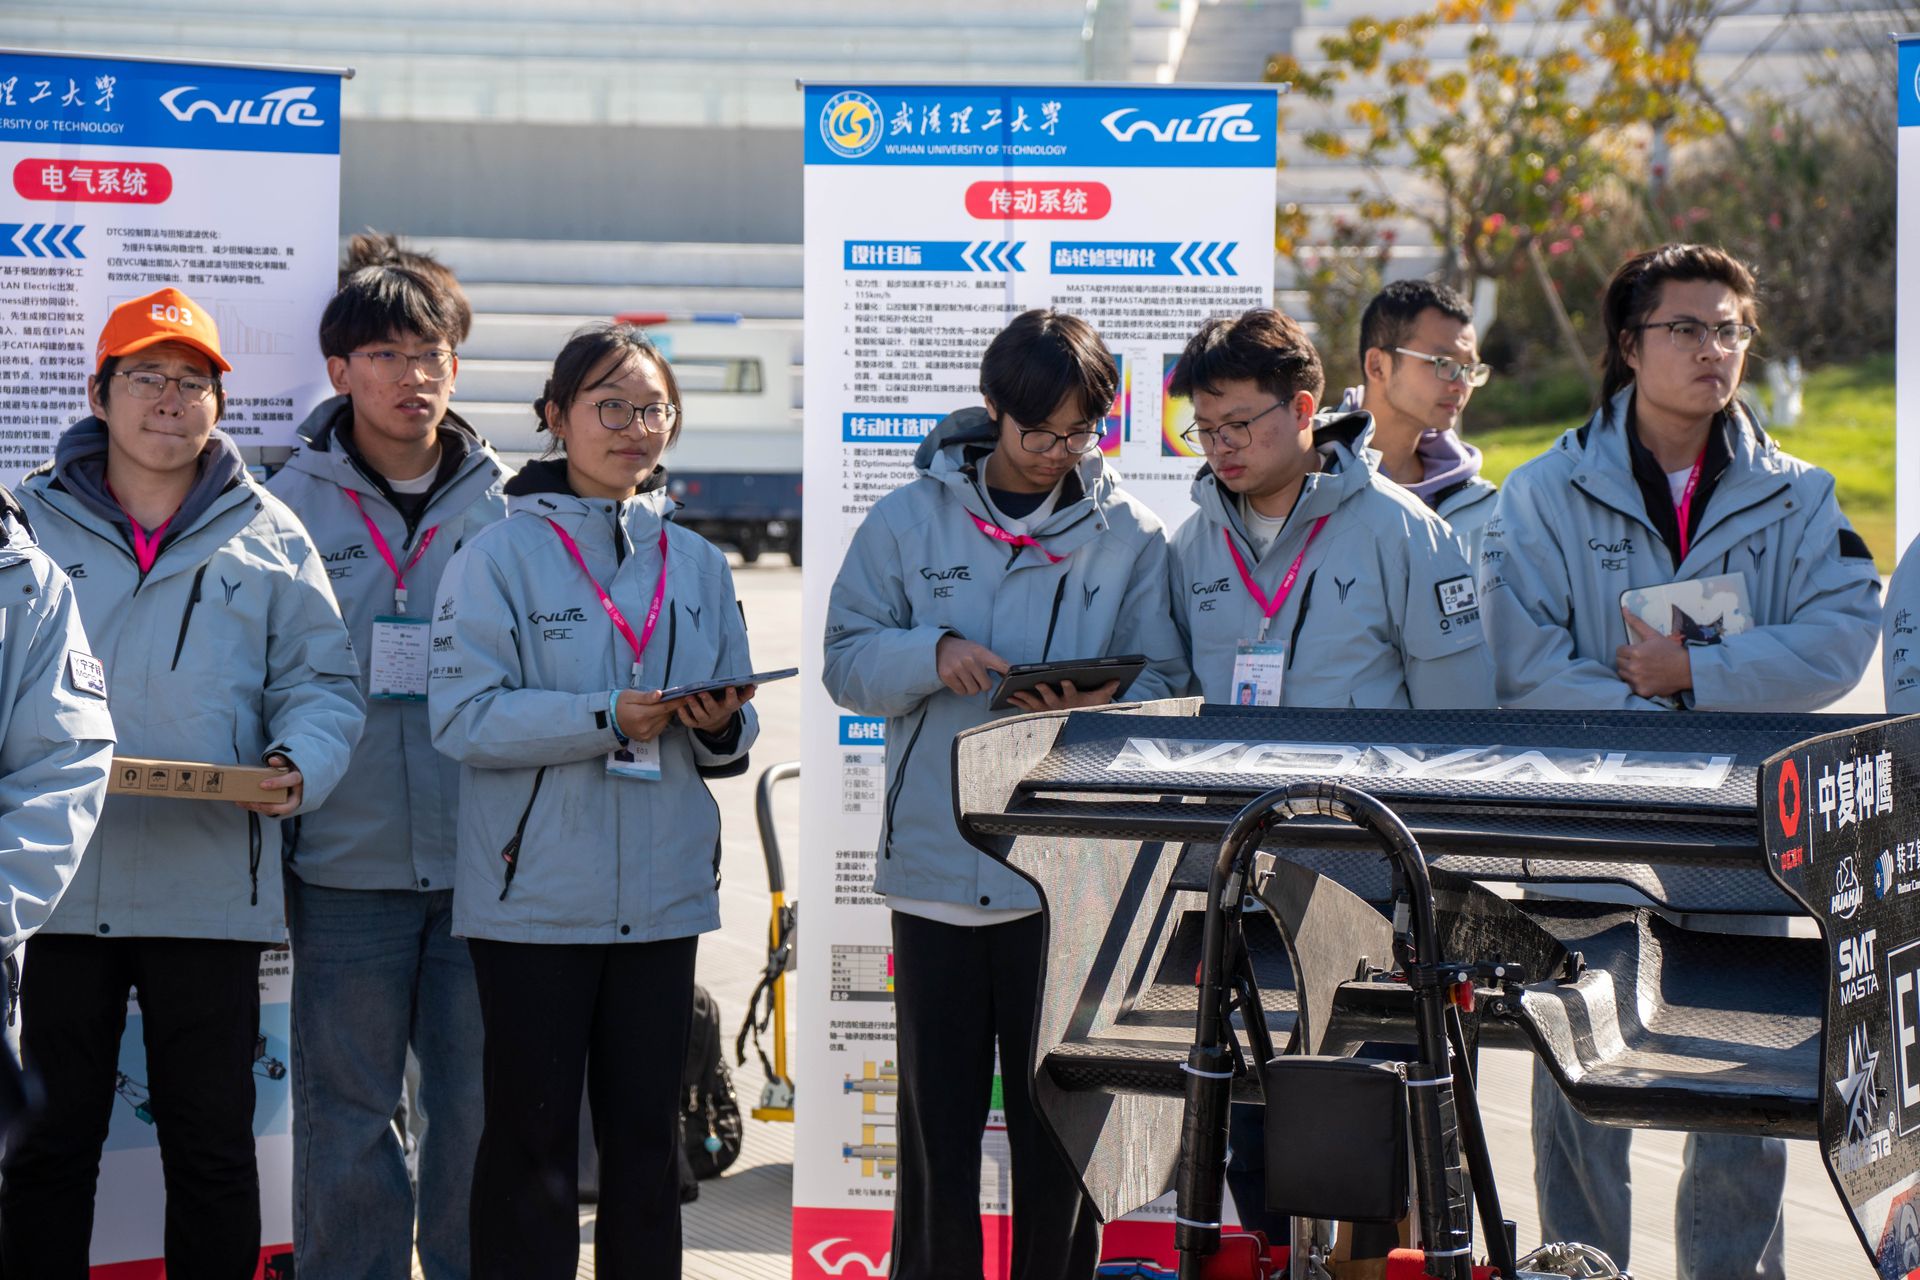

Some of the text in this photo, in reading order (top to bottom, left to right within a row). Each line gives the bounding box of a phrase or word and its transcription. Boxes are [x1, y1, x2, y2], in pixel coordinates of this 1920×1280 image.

[35, 119, 49, 130] OF
[53, 121, 124, 133] TECHNOLOGY
[885, 144, 1067, 156] WUHAN UNIVERSITY OF TECHNOLOGY
[41, 165, 148, 196] 电气系统
[989, 188, 1088, 214] 传动系统
[851, 245, 922, 265] 设计目标
[151, 304, 193, 326] E03
[433, 636, 453, 648] SMT
[543, 628, 574, 641] RSC
[1127, 738, 1732, 788] VOYAH
[1818, 750, 1894, 832] 中复神鹰
[1831, 886, 1863, 914] HUAHAI
[1840, 929, 1877, 983] SMT
[1840, 973, 1879, 1006] MASTA
